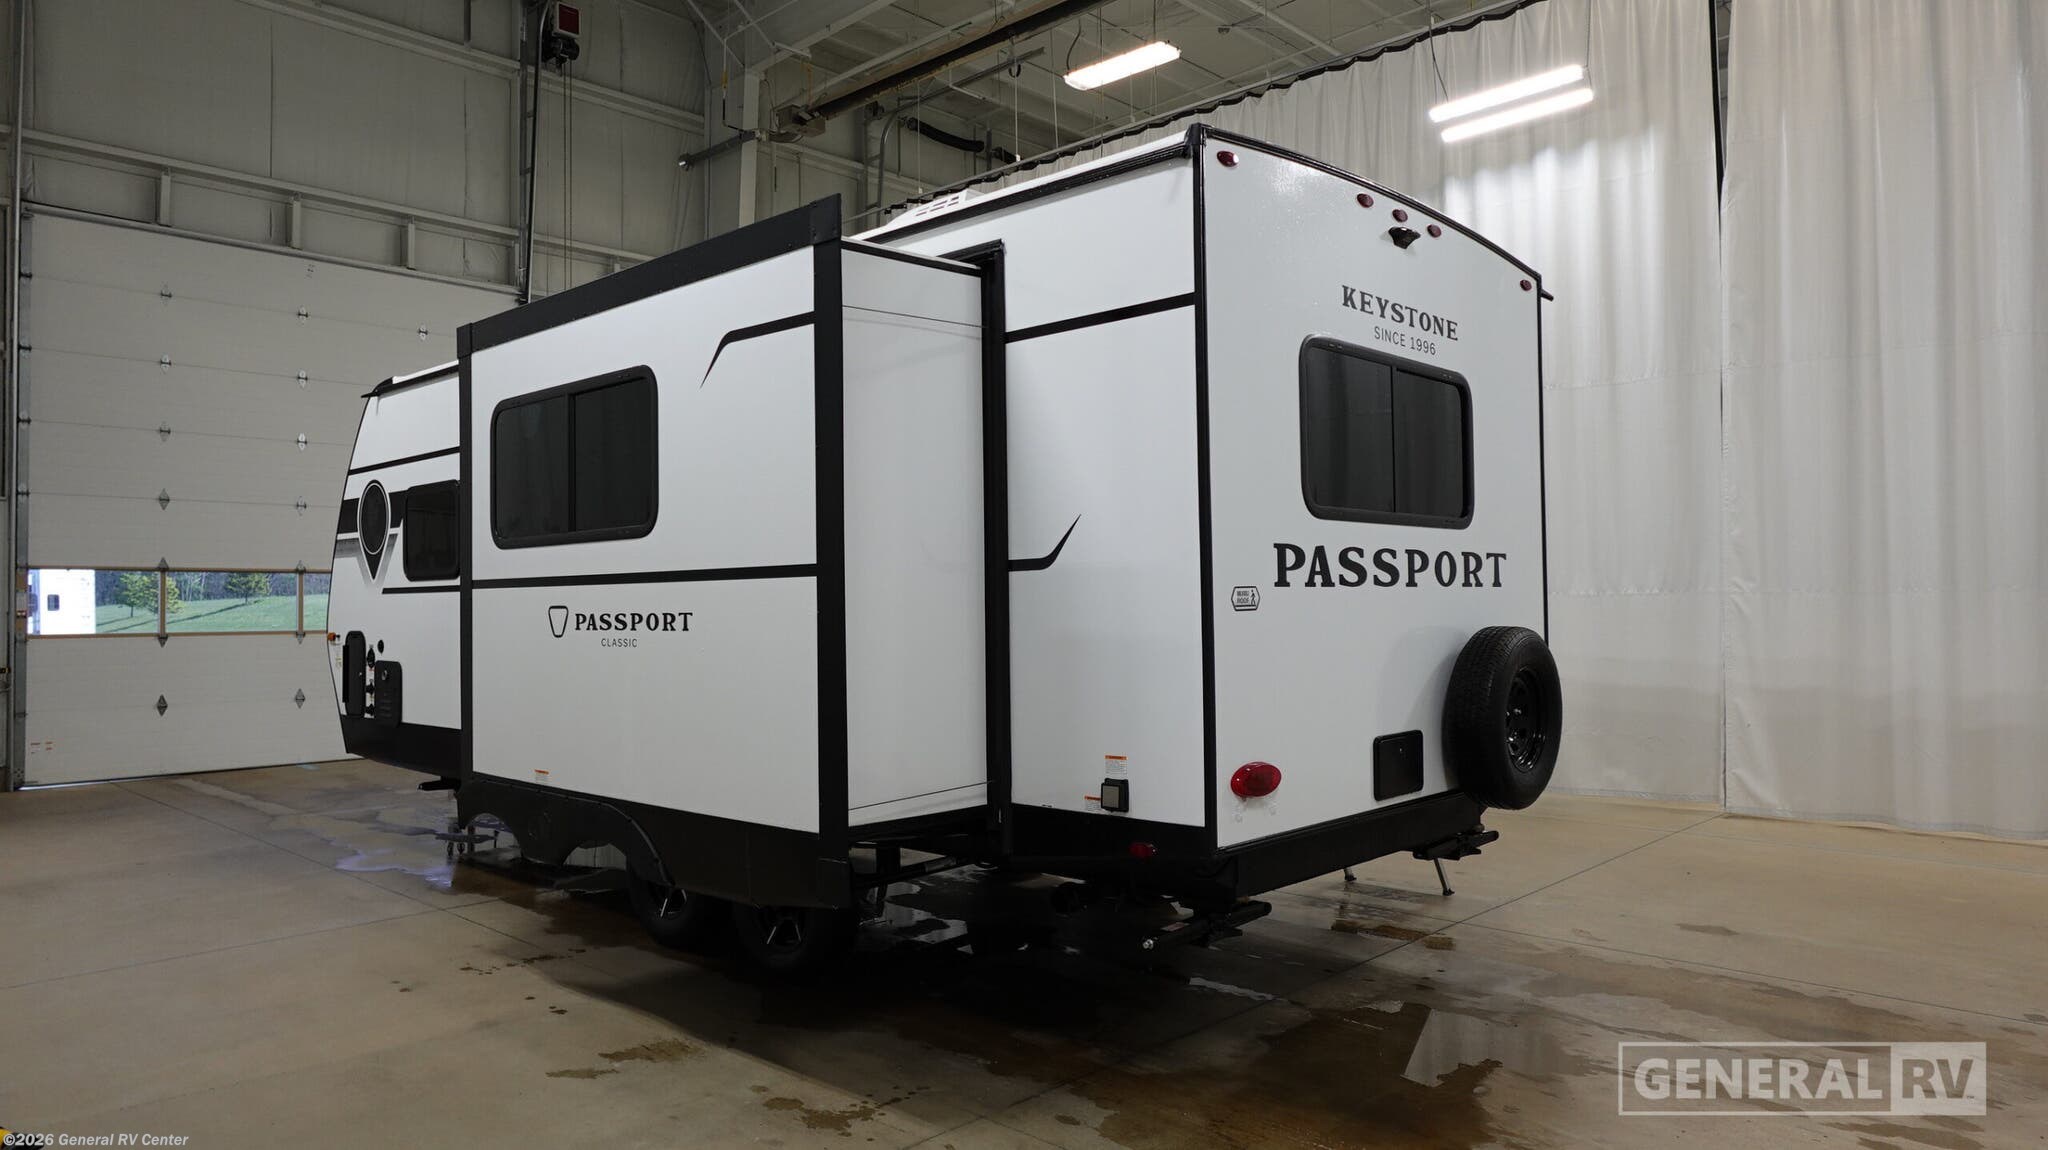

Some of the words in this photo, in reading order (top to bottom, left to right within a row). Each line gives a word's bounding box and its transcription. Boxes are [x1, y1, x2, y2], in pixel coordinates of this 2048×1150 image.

[1342, 285, 1458, 341] KEYSTONE
[1374, 325, 1406, 347] SINCE
[1410, 336, 1436, 356] 1996
[1273, 543, 1507, 588] PASSPORT
[575, 612, 693, 631] PASSPORT
[600, 638, 638, 648] CLASSIC
